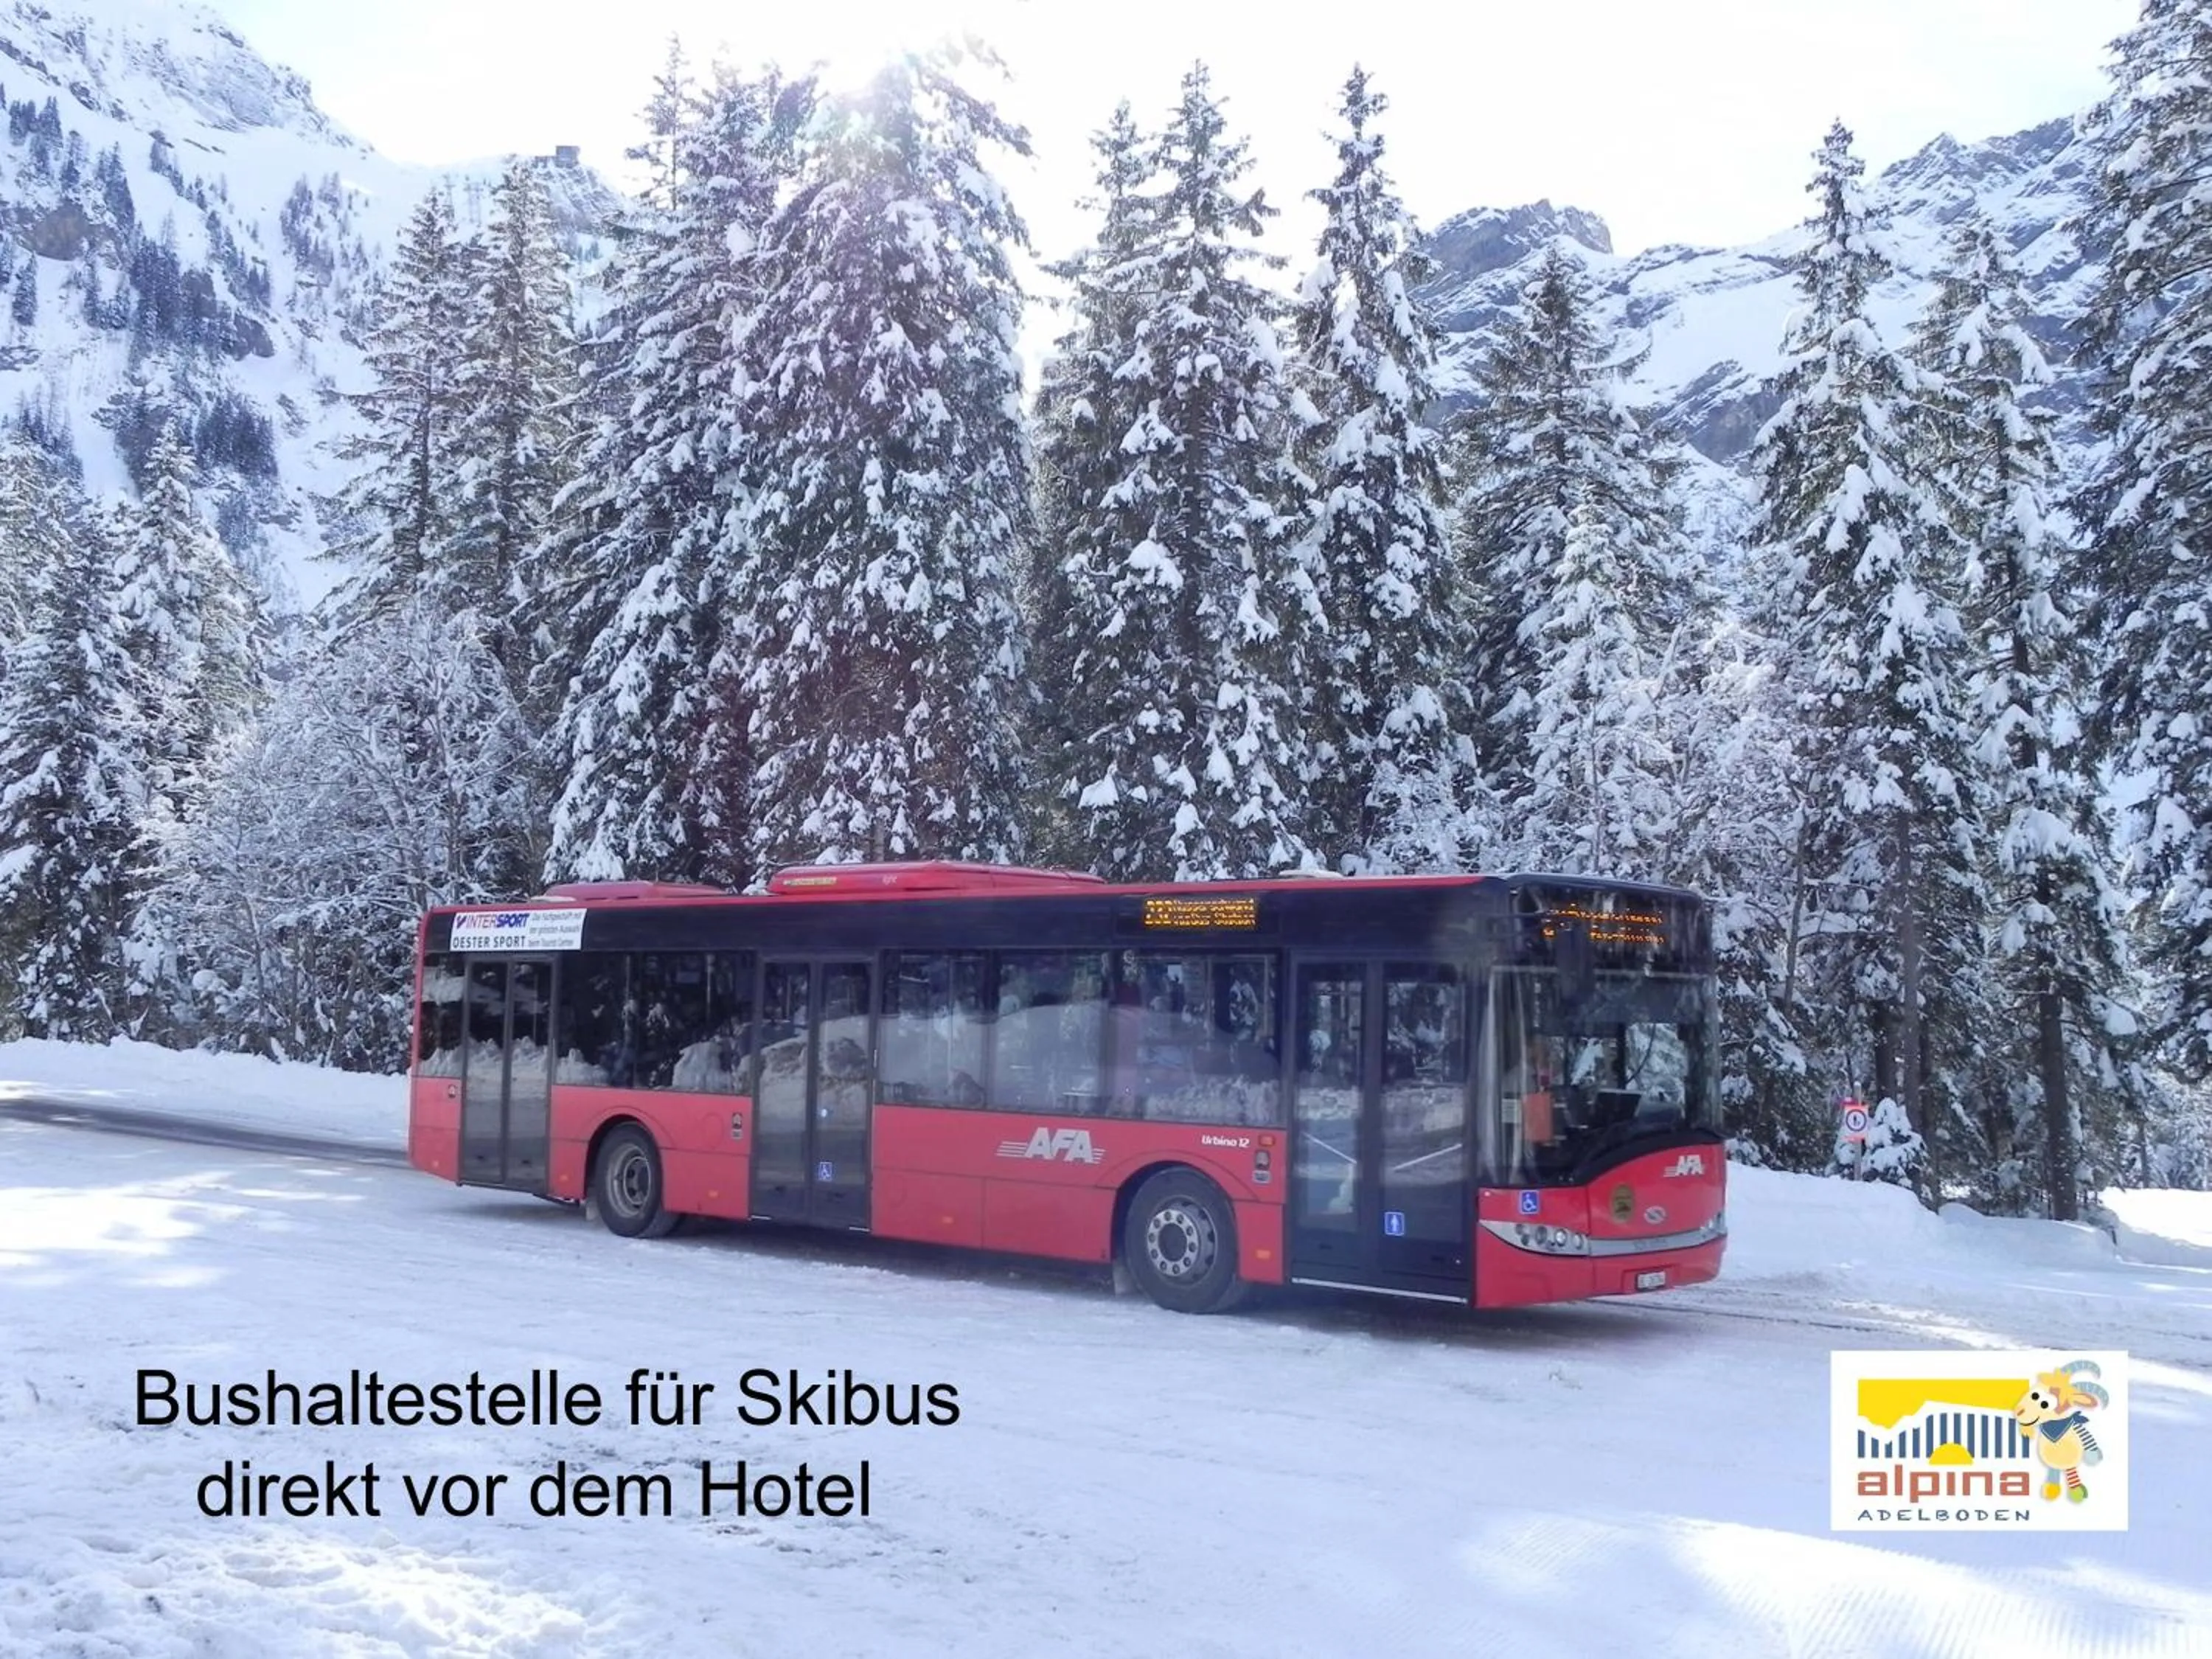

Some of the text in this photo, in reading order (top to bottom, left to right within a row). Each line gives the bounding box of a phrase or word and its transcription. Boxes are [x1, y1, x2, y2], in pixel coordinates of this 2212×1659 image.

[452, 936, 490, 949] OESTER
[493, 935, 526, 948] SPORT
[1024, 1126, 1095, 1164] AFA
[1201, 1135, 1251, 1149] Urbino 12
[1674, 1154, 1705, 1176] AFA
